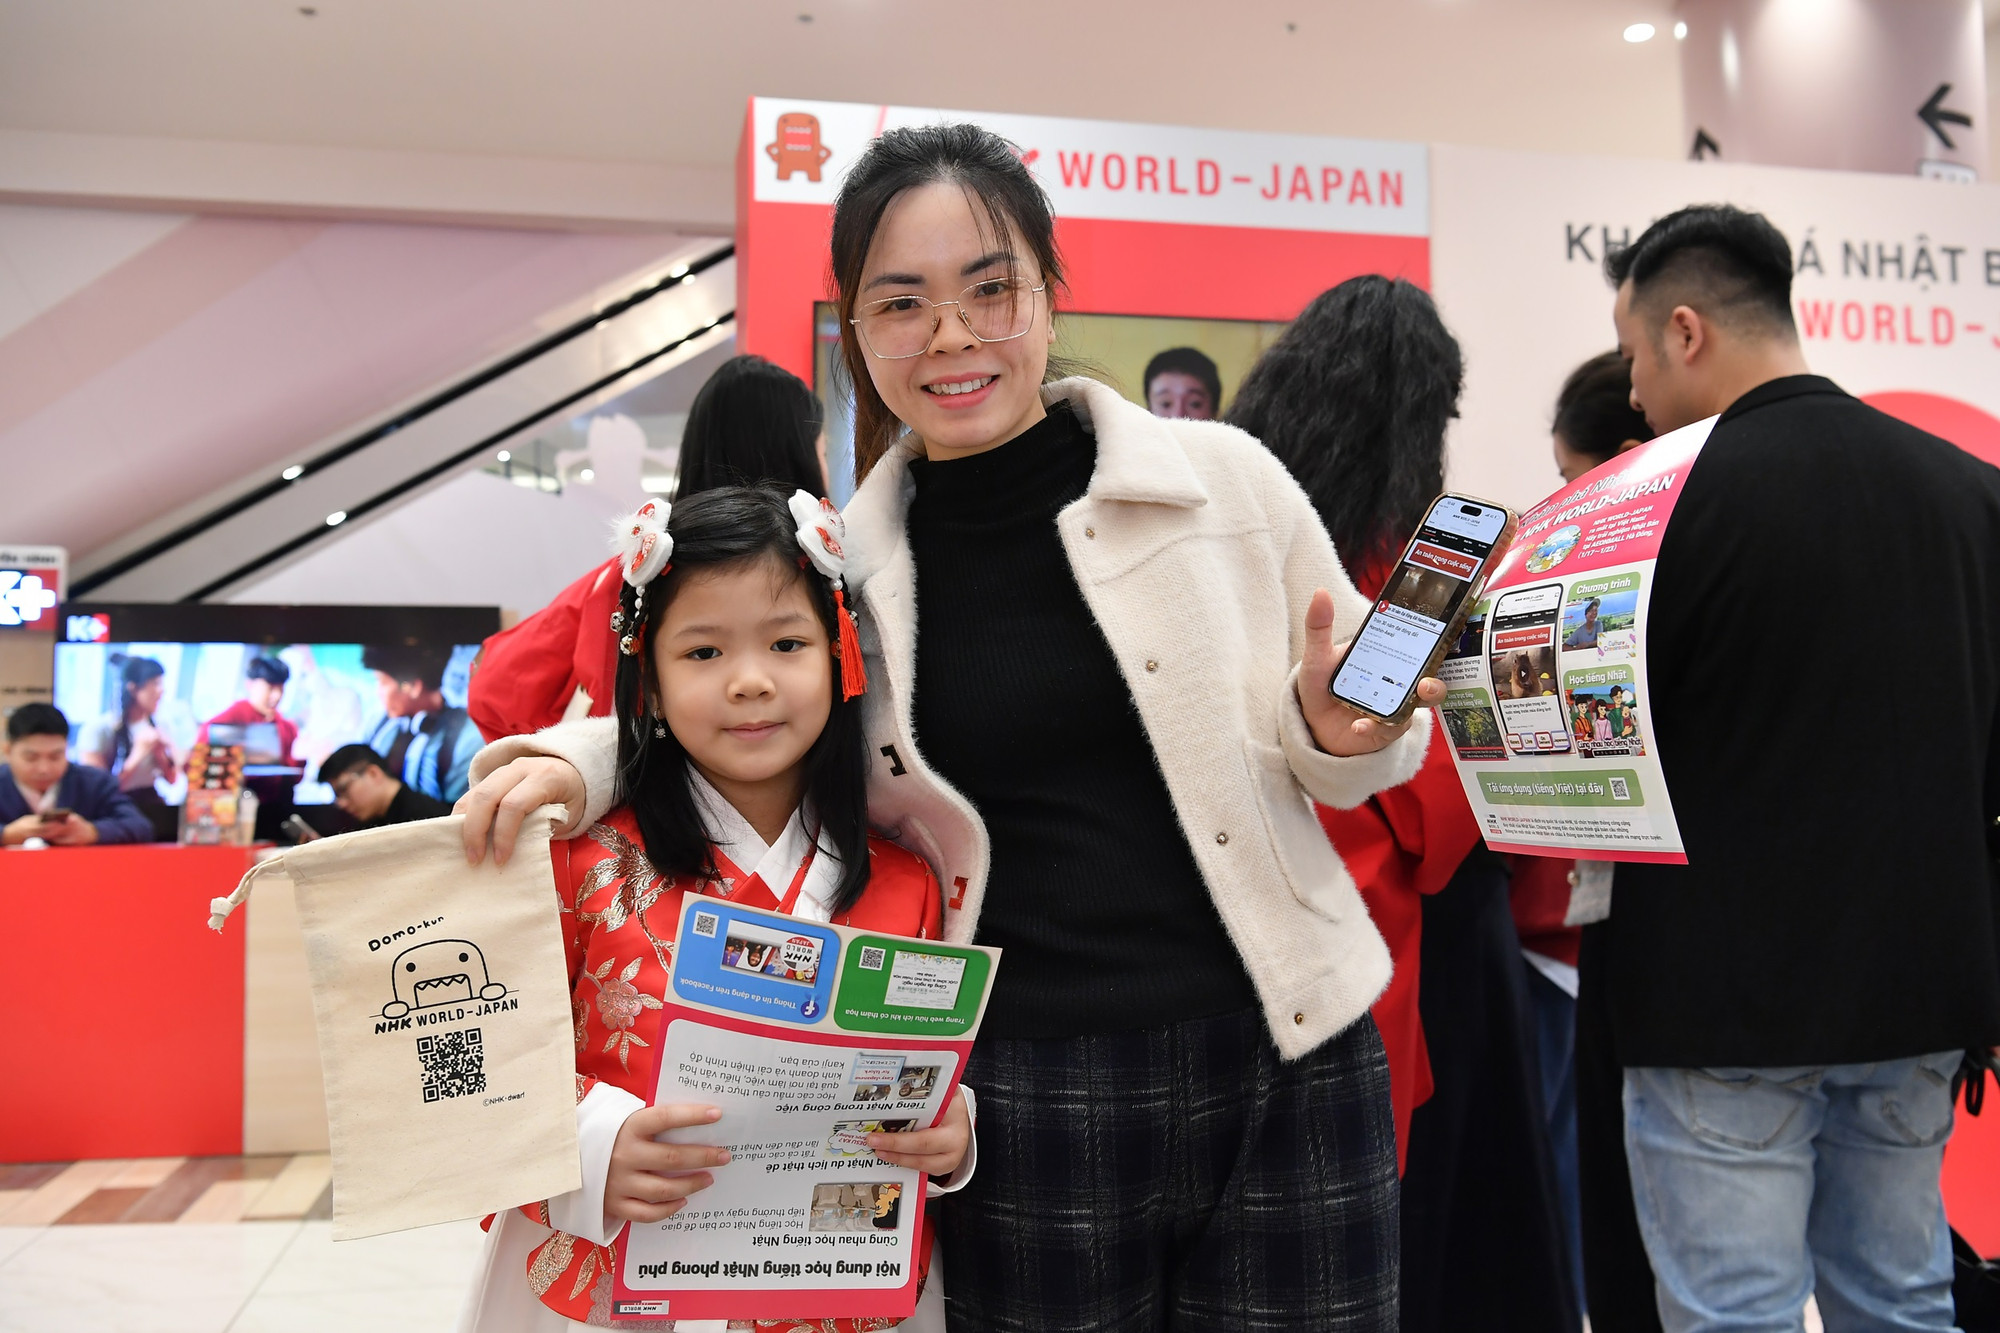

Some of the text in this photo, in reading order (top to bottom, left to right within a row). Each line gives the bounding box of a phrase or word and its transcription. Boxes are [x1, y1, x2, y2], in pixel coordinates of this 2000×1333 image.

[1842, 232, 1968, 292] NHẬT
[1799, 298, 2000, 348] WORLD-
[1520, 515, 1557, 540] NHK
[1552, 473, 1677, 526] WORLD-JAPAN
[1607, 505, 1654, 521] WORLD-JAPAN
[1631, 522, 1647, 530] Nhật
[1591, 536, 1624, 547] AEONMALL
[1422, 551, 1433, 560] toàn
[1434, 554, 1447, 564] trong
[1459, 562, 1472, 572] sống
[1577, 577, 1631, 594] Chương trình
[1569, 670, 1627, 685] Học tiếng Nhật
[1487, 783, 1604, 796] Tải ứng dụng (tiếng Việt) tại đây
[368, 916, 444, 952] Domo-kun
[787, 945, 813, 954] WORLD
[784, 952, 811, 962] NHK
[680, 978, 796, 1009] Thông tin đa dạng trên Facebook
[374, 998, 519, 1035] NHK WORLD-JAPAN
[845, 1009, 859, 1017] họa
[860, 1011, 879, 1019] thảm
[880, 1012, 889, 1020] có
[902, 1014, 914, 1022] ích
[915, 1015, 929, 1023] hữu
[946, 1016, 965, 1024] Trang
[689, 1051, 842, 1080] kinh doanh và cải thiện trình độ
[779, 1056, 845, 1069] kanji của bạn.
[679, 1063, 839, 1089] quả tại nơi làm việc, hiểu văn hoá
[678, 1076, 836, 1100] Học các mẫu câu thực tế và hiệu
[775, 1100, 926, 1114] Tiếng Nhật trong công việc
[740, 1143, 763, 1151] Nhật
[766, 1151, 782, 1159] các
[766, 1158, 874, 1173] Nhật du lịch thật dễ
[702, 1210, 711, 1218] đi
[713, 1210, 725, 1218] và
[727, 1208, 749, 1218] ngày
[752, 1208, 785, 1218] thường
[788, 1208, 805, 1217] tiếp
[661, 1220, 803, 1232] Học tiếng Nhật cơ bản để giao
[752, 1234, 898, 1247] Cùng nhau học tiếng Nhật
[638, 1260, 900, 1278] Nội dung học tiếng Nhật phong phú
